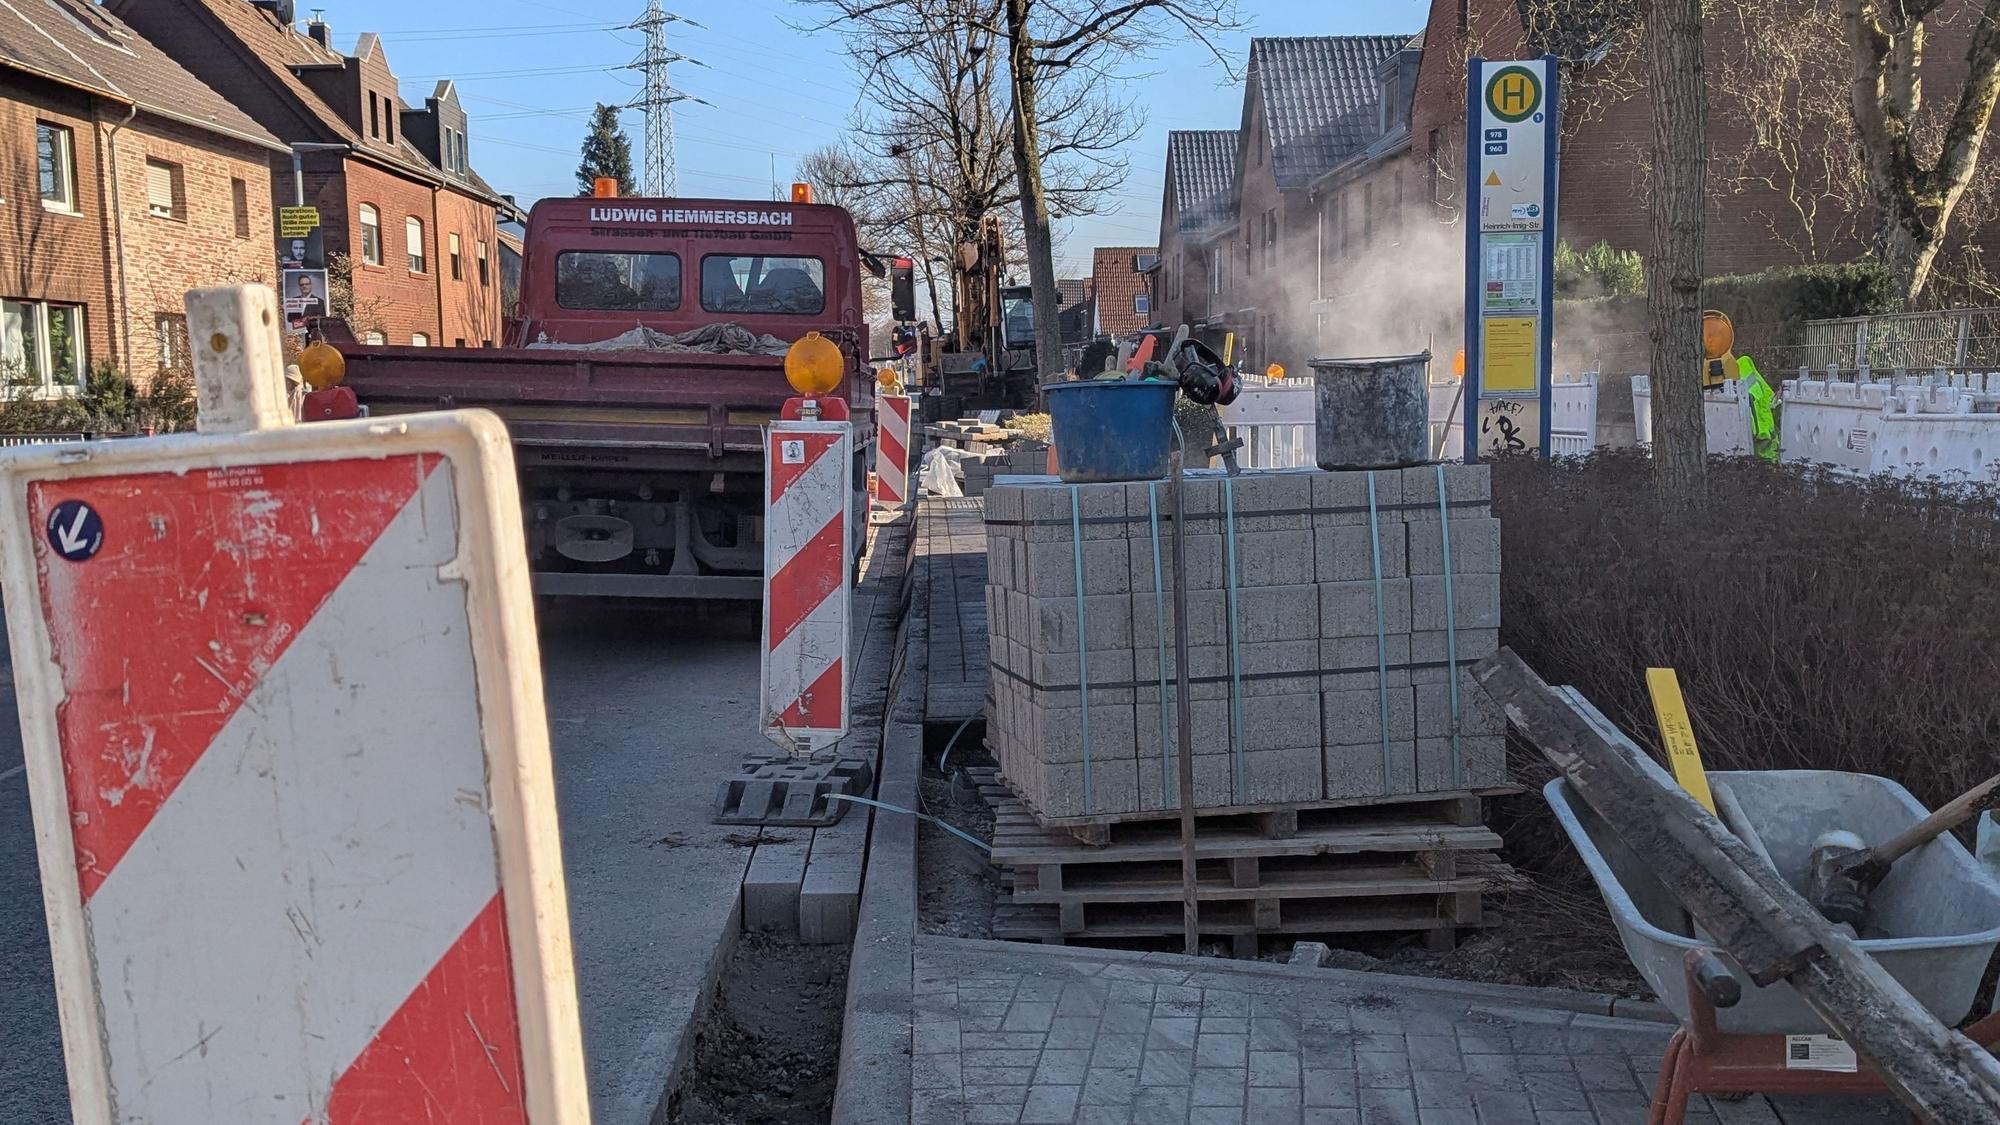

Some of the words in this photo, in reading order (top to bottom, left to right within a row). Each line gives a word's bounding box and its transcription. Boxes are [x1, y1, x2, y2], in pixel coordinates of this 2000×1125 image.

[1503, 78, 1525, 110] H
[590, 207, 657, 222] LUDWIG
[661, 208, 793, 226] HEMMERSBACH
[662, 228, 689, 239] und
